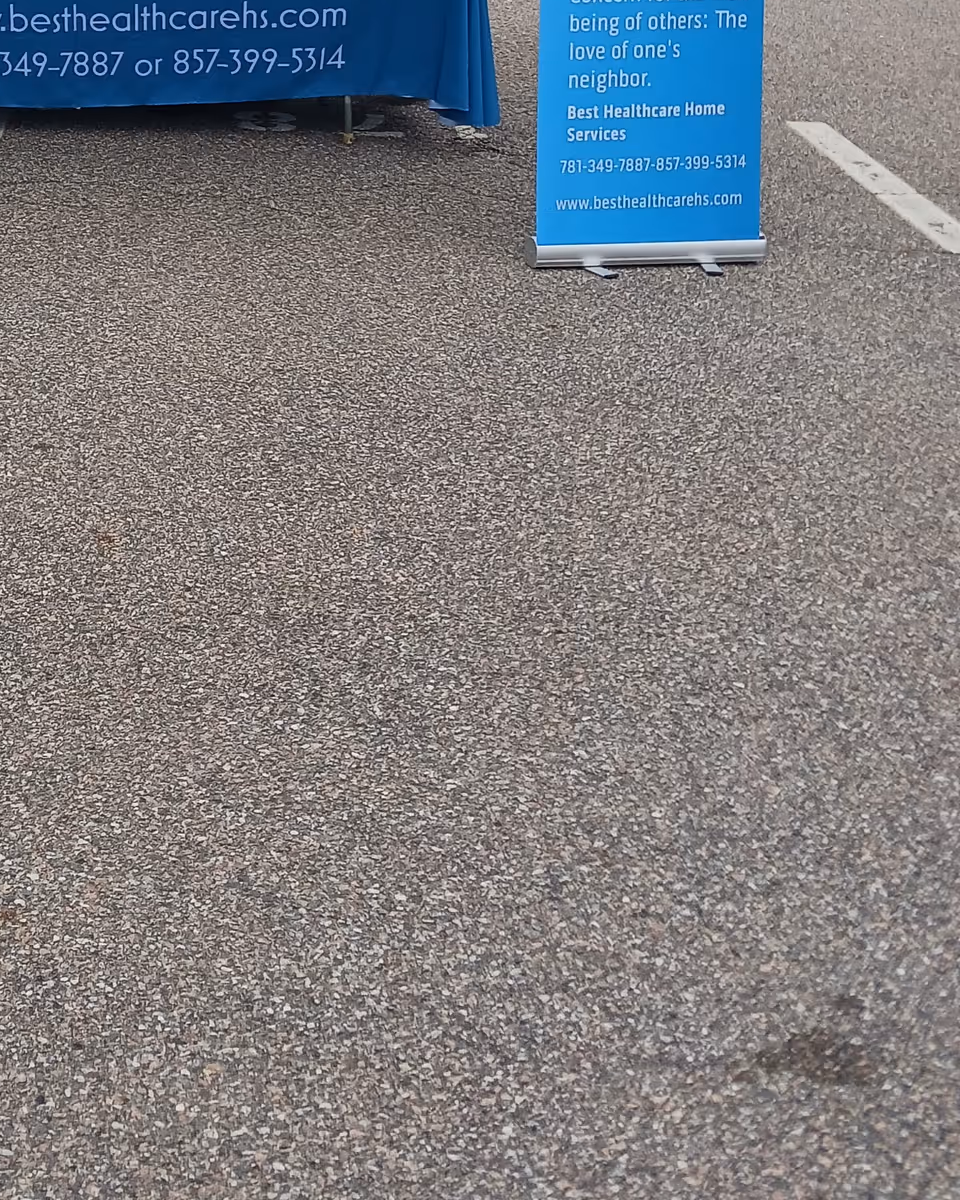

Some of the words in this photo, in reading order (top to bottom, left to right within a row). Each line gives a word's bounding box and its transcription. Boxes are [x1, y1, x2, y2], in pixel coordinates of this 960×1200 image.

[568, 13, 620, 36] being
[625, 12, 642, 32] of
[647, 12, 708, 31] others:
[714, 10, 748, 29] The
[135, 59, 162, 76] or
[174, 45, 345, 74] 857-399-5314
[568, 41, 606, 61] love
[611, 40, 629, 60] of
[633, 40, 681, 60] one's
[568, 69, 652, 93] neighbor.
[567, 105, 599, 120] Best
[603, 103, 681, 120] Healthcare
[685, 101, 725, 117] Home
[567, 126, 627, 142] Services
[560, 154, 747, 174] 781-349-7887-857-399-5314
[556, 190, 743, 212] www.besthealthcarehs.com
